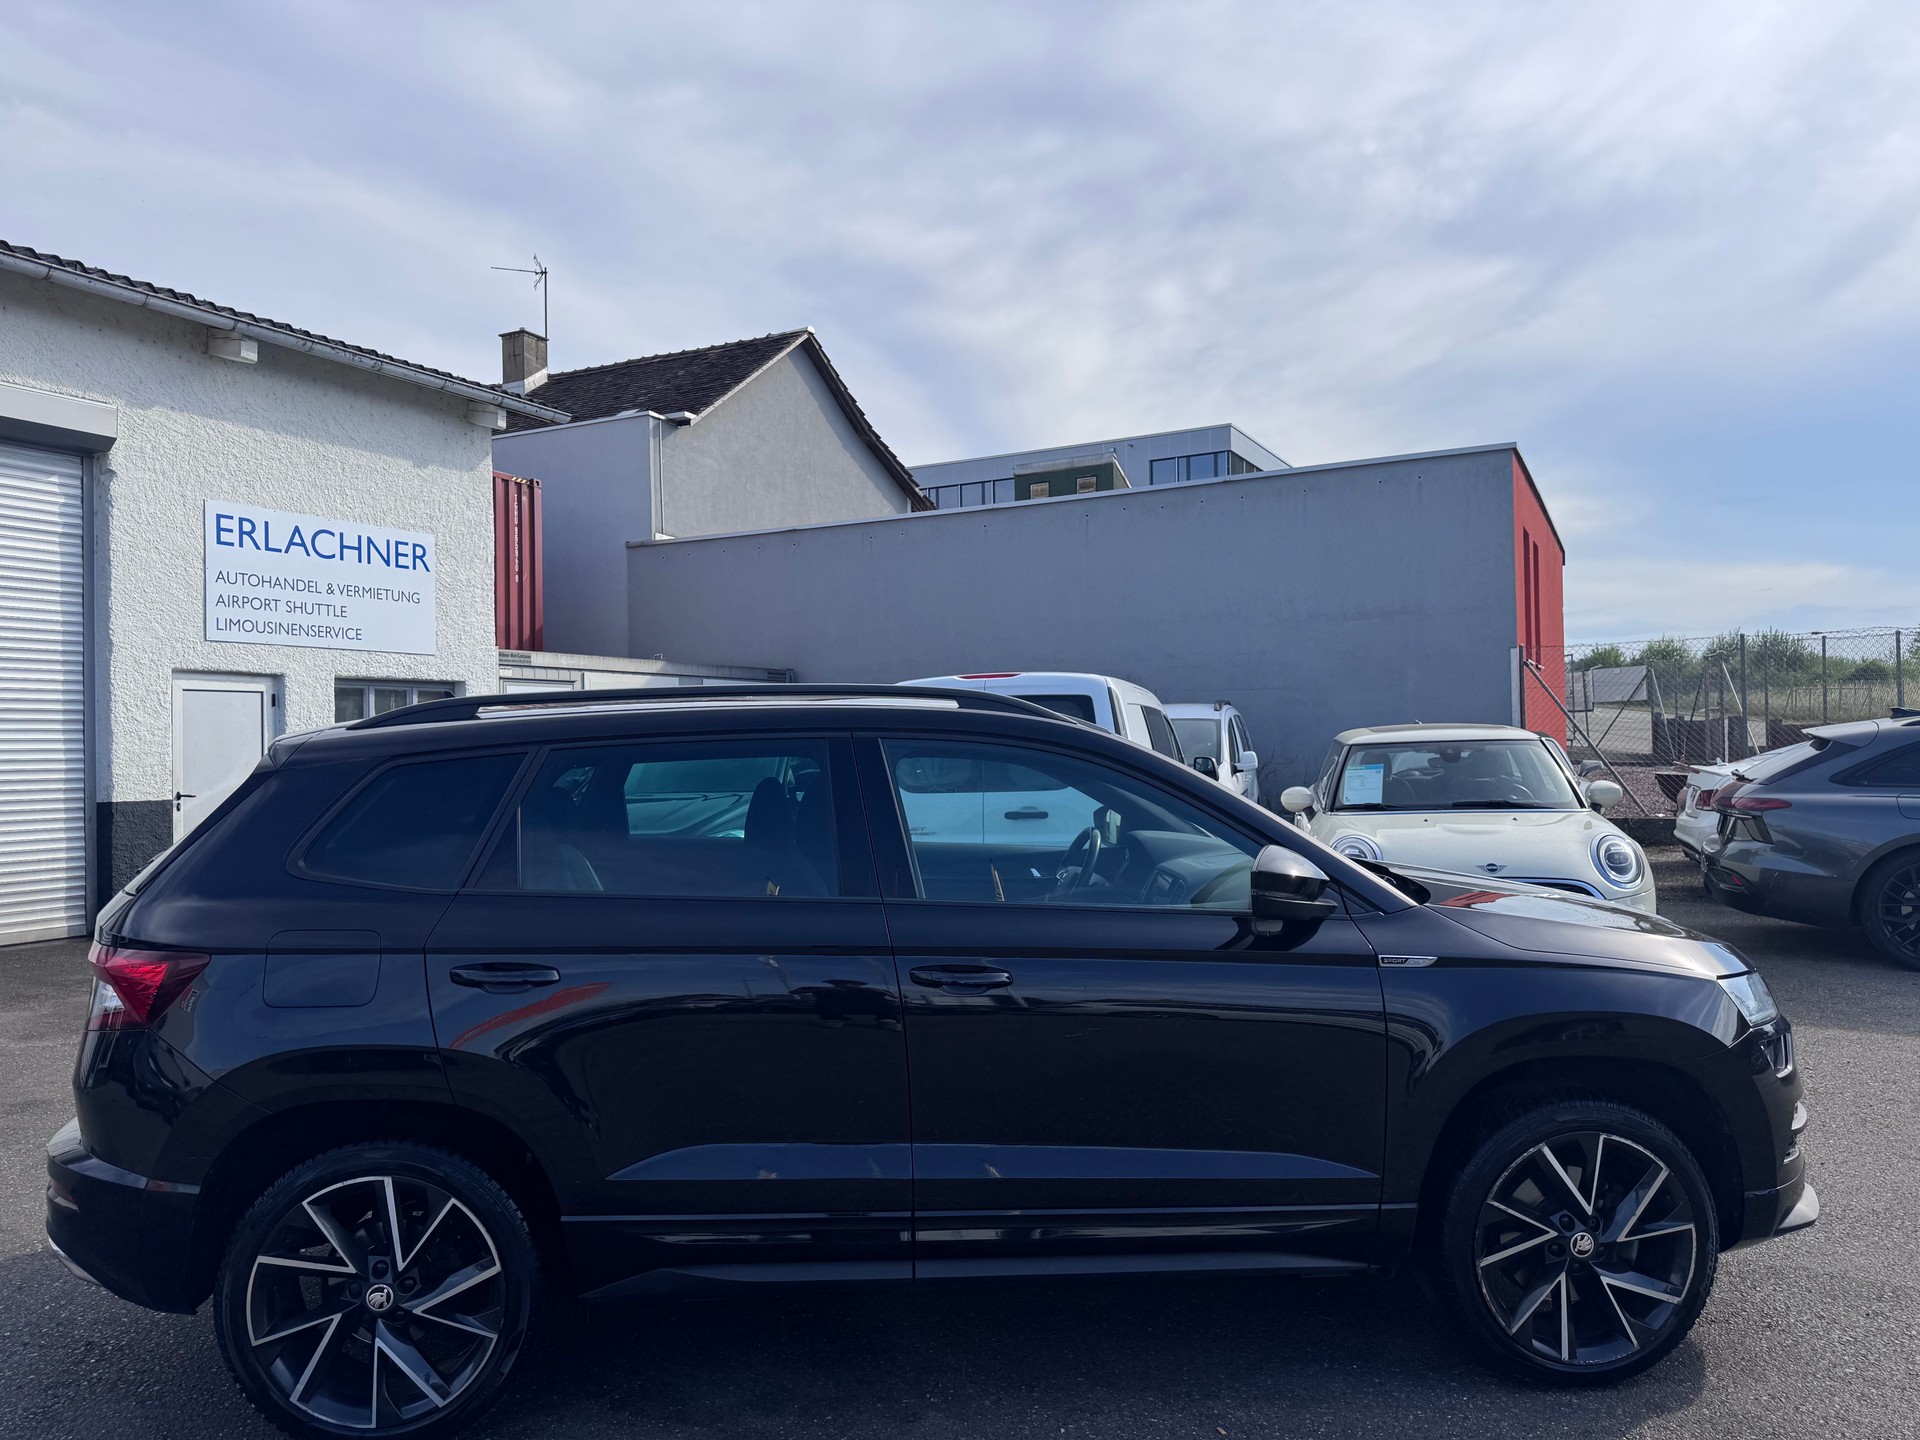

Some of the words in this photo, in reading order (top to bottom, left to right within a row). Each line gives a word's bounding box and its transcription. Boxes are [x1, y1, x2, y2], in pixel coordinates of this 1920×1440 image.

[215, 513, 431, 572] ERLACHNER
[215, 570, 322, 594] AUTOHANDEL
[326, 583, 335, 595] &
[337, 584, 421, 604] VERMIETUNG
[215, 594, 281, 612] AIRPORT
[286, 600, 348, 618] SHUTTLE
[216, 617, 363, 640] LIMOUSINENSERVICE
